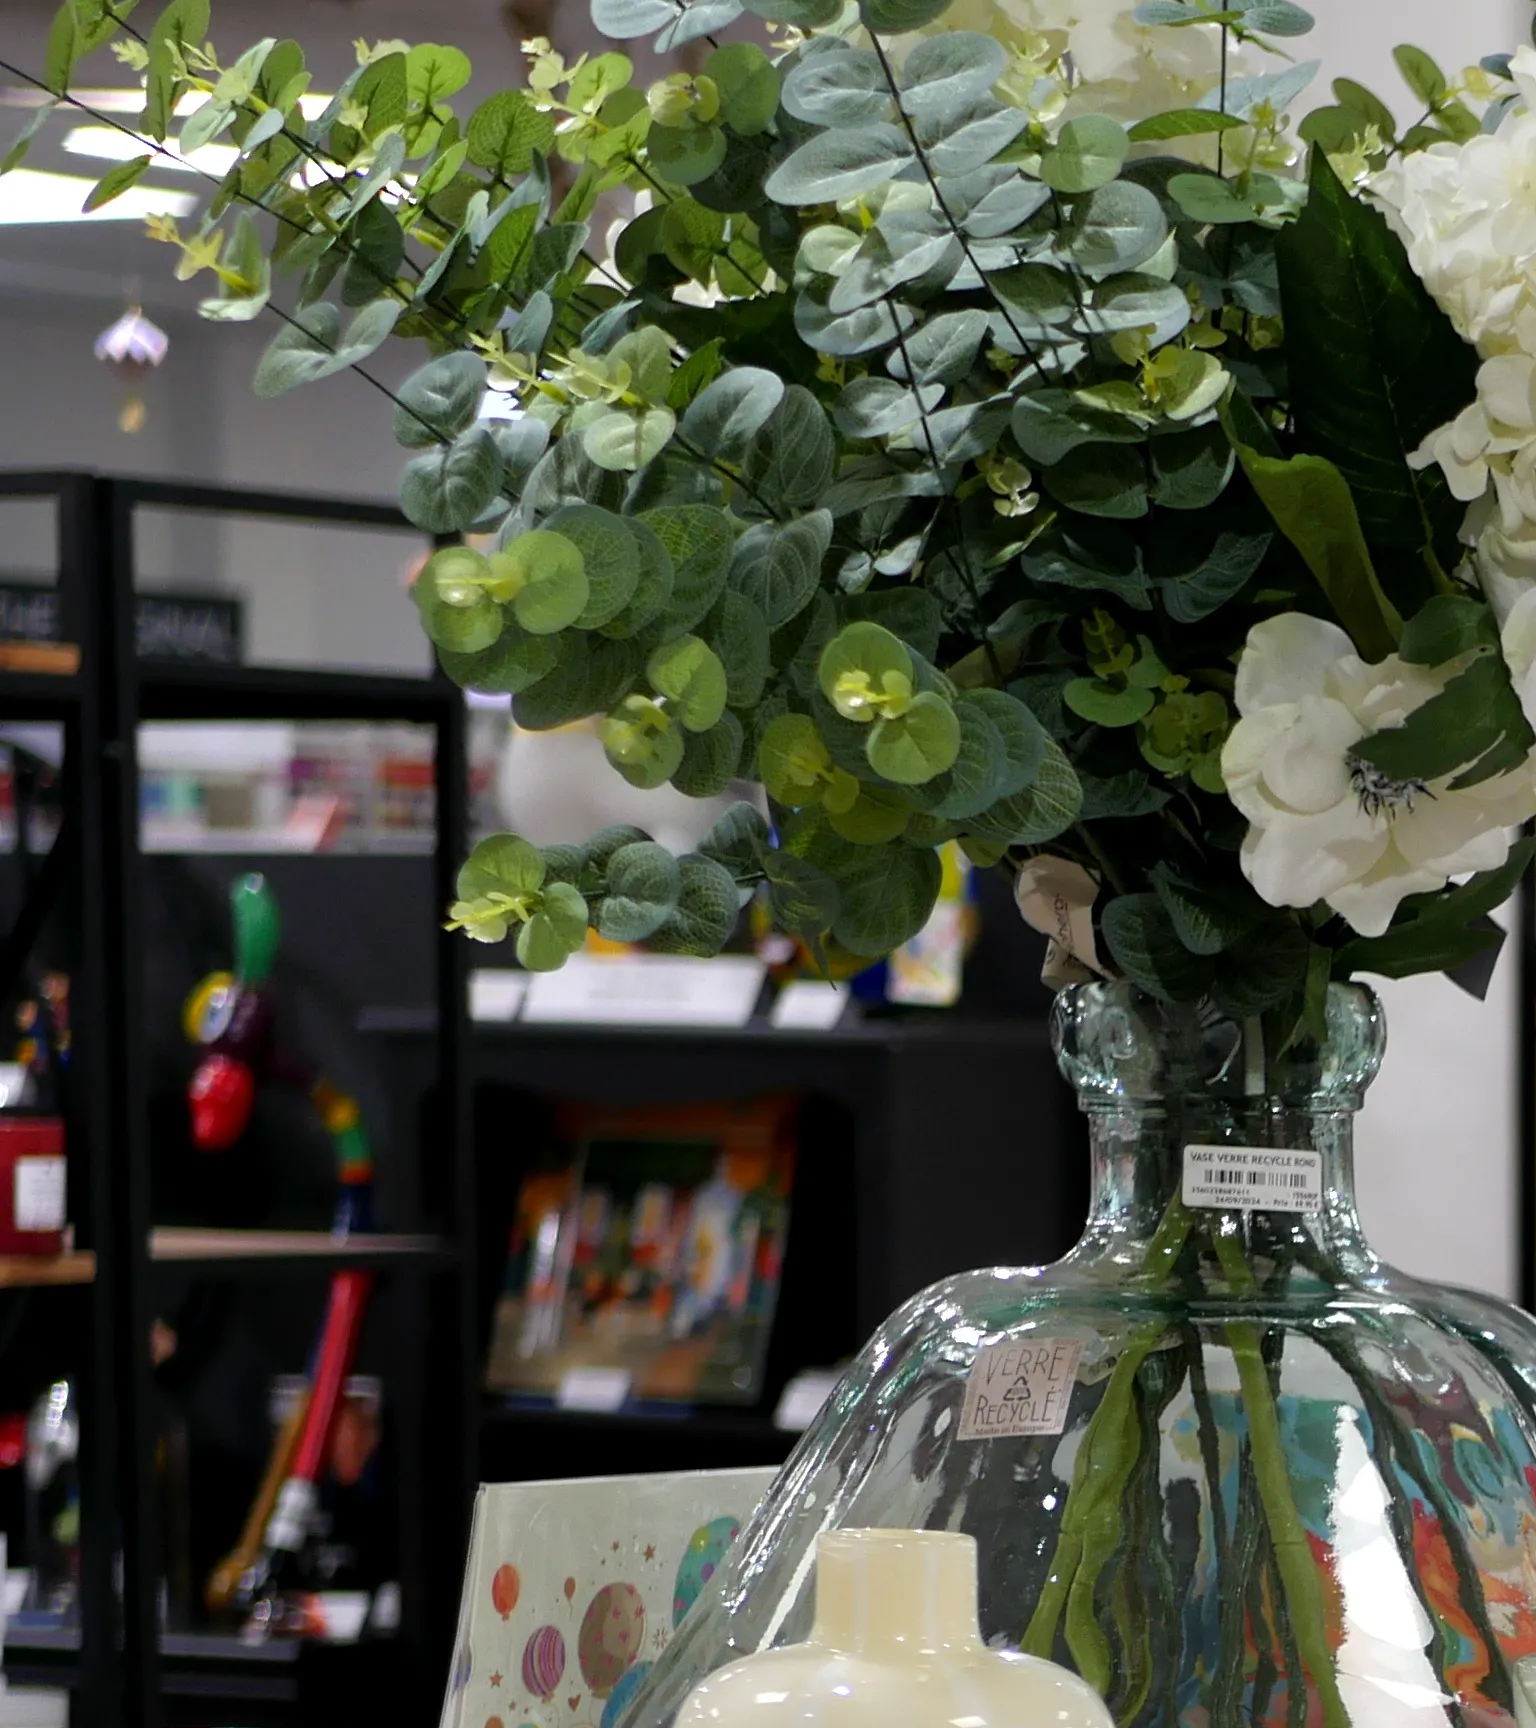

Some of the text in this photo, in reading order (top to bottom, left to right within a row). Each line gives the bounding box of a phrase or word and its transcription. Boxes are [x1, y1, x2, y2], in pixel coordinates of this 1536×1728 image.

[1190, 1152, 1213, 1162] VASE
[1217, 1154, 1248, 1164] VERRE
[1251, 1155, 1291, 1166] RECYCLE
[985, 1346, 1066, 1385] VERRE
[973, 1385, 1053, 1426] RECYCLÉ
